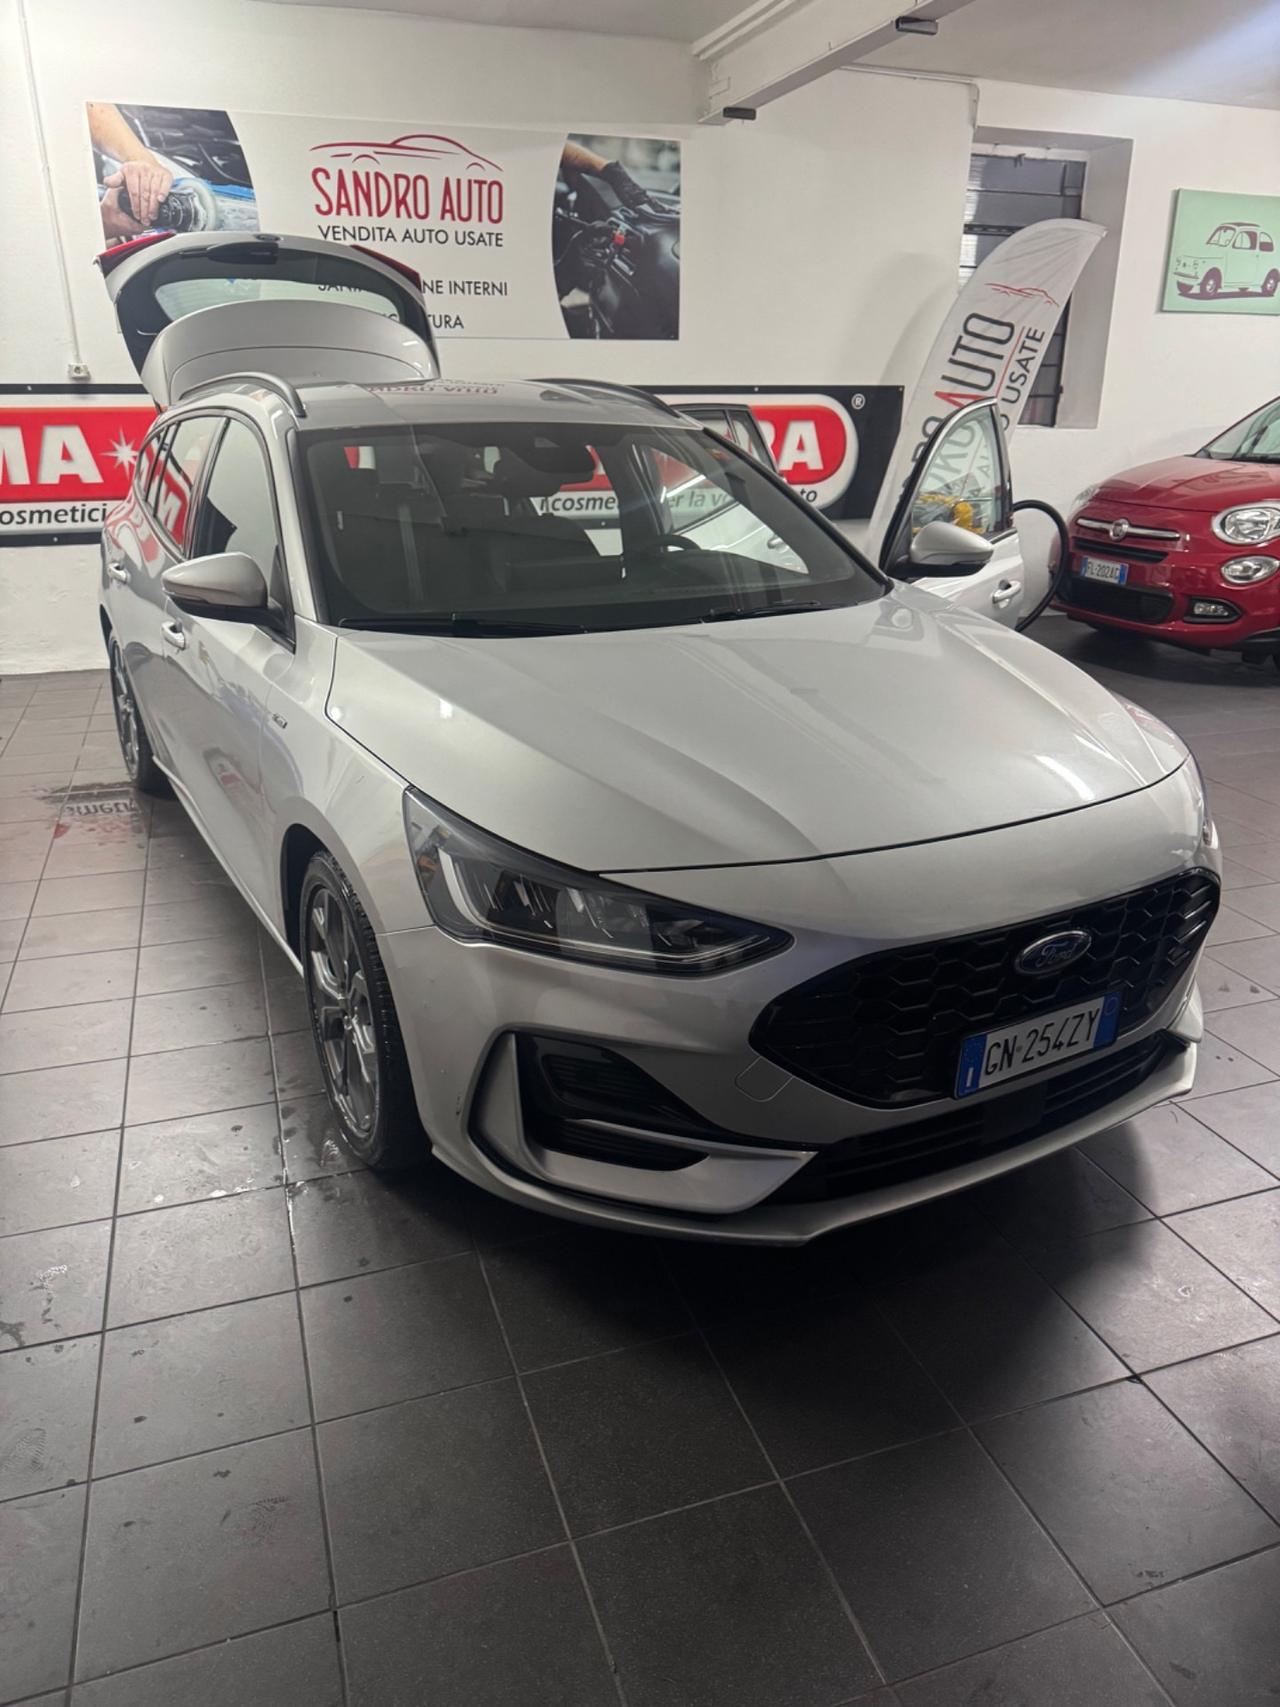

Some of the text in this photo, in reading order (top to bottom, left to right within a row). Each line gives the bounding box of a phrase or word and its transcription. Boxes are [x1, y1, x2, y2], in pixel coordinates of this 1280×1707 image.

[311, 167, 504, 224] SANDRO AUTO
[318, 225, 504, 247] VENDITA AUTO USATE
[449, 281, 508, 297] INTERNI
[1002, 327, 1045, 404] USATE
[551, 495, 617, 511] cosme
